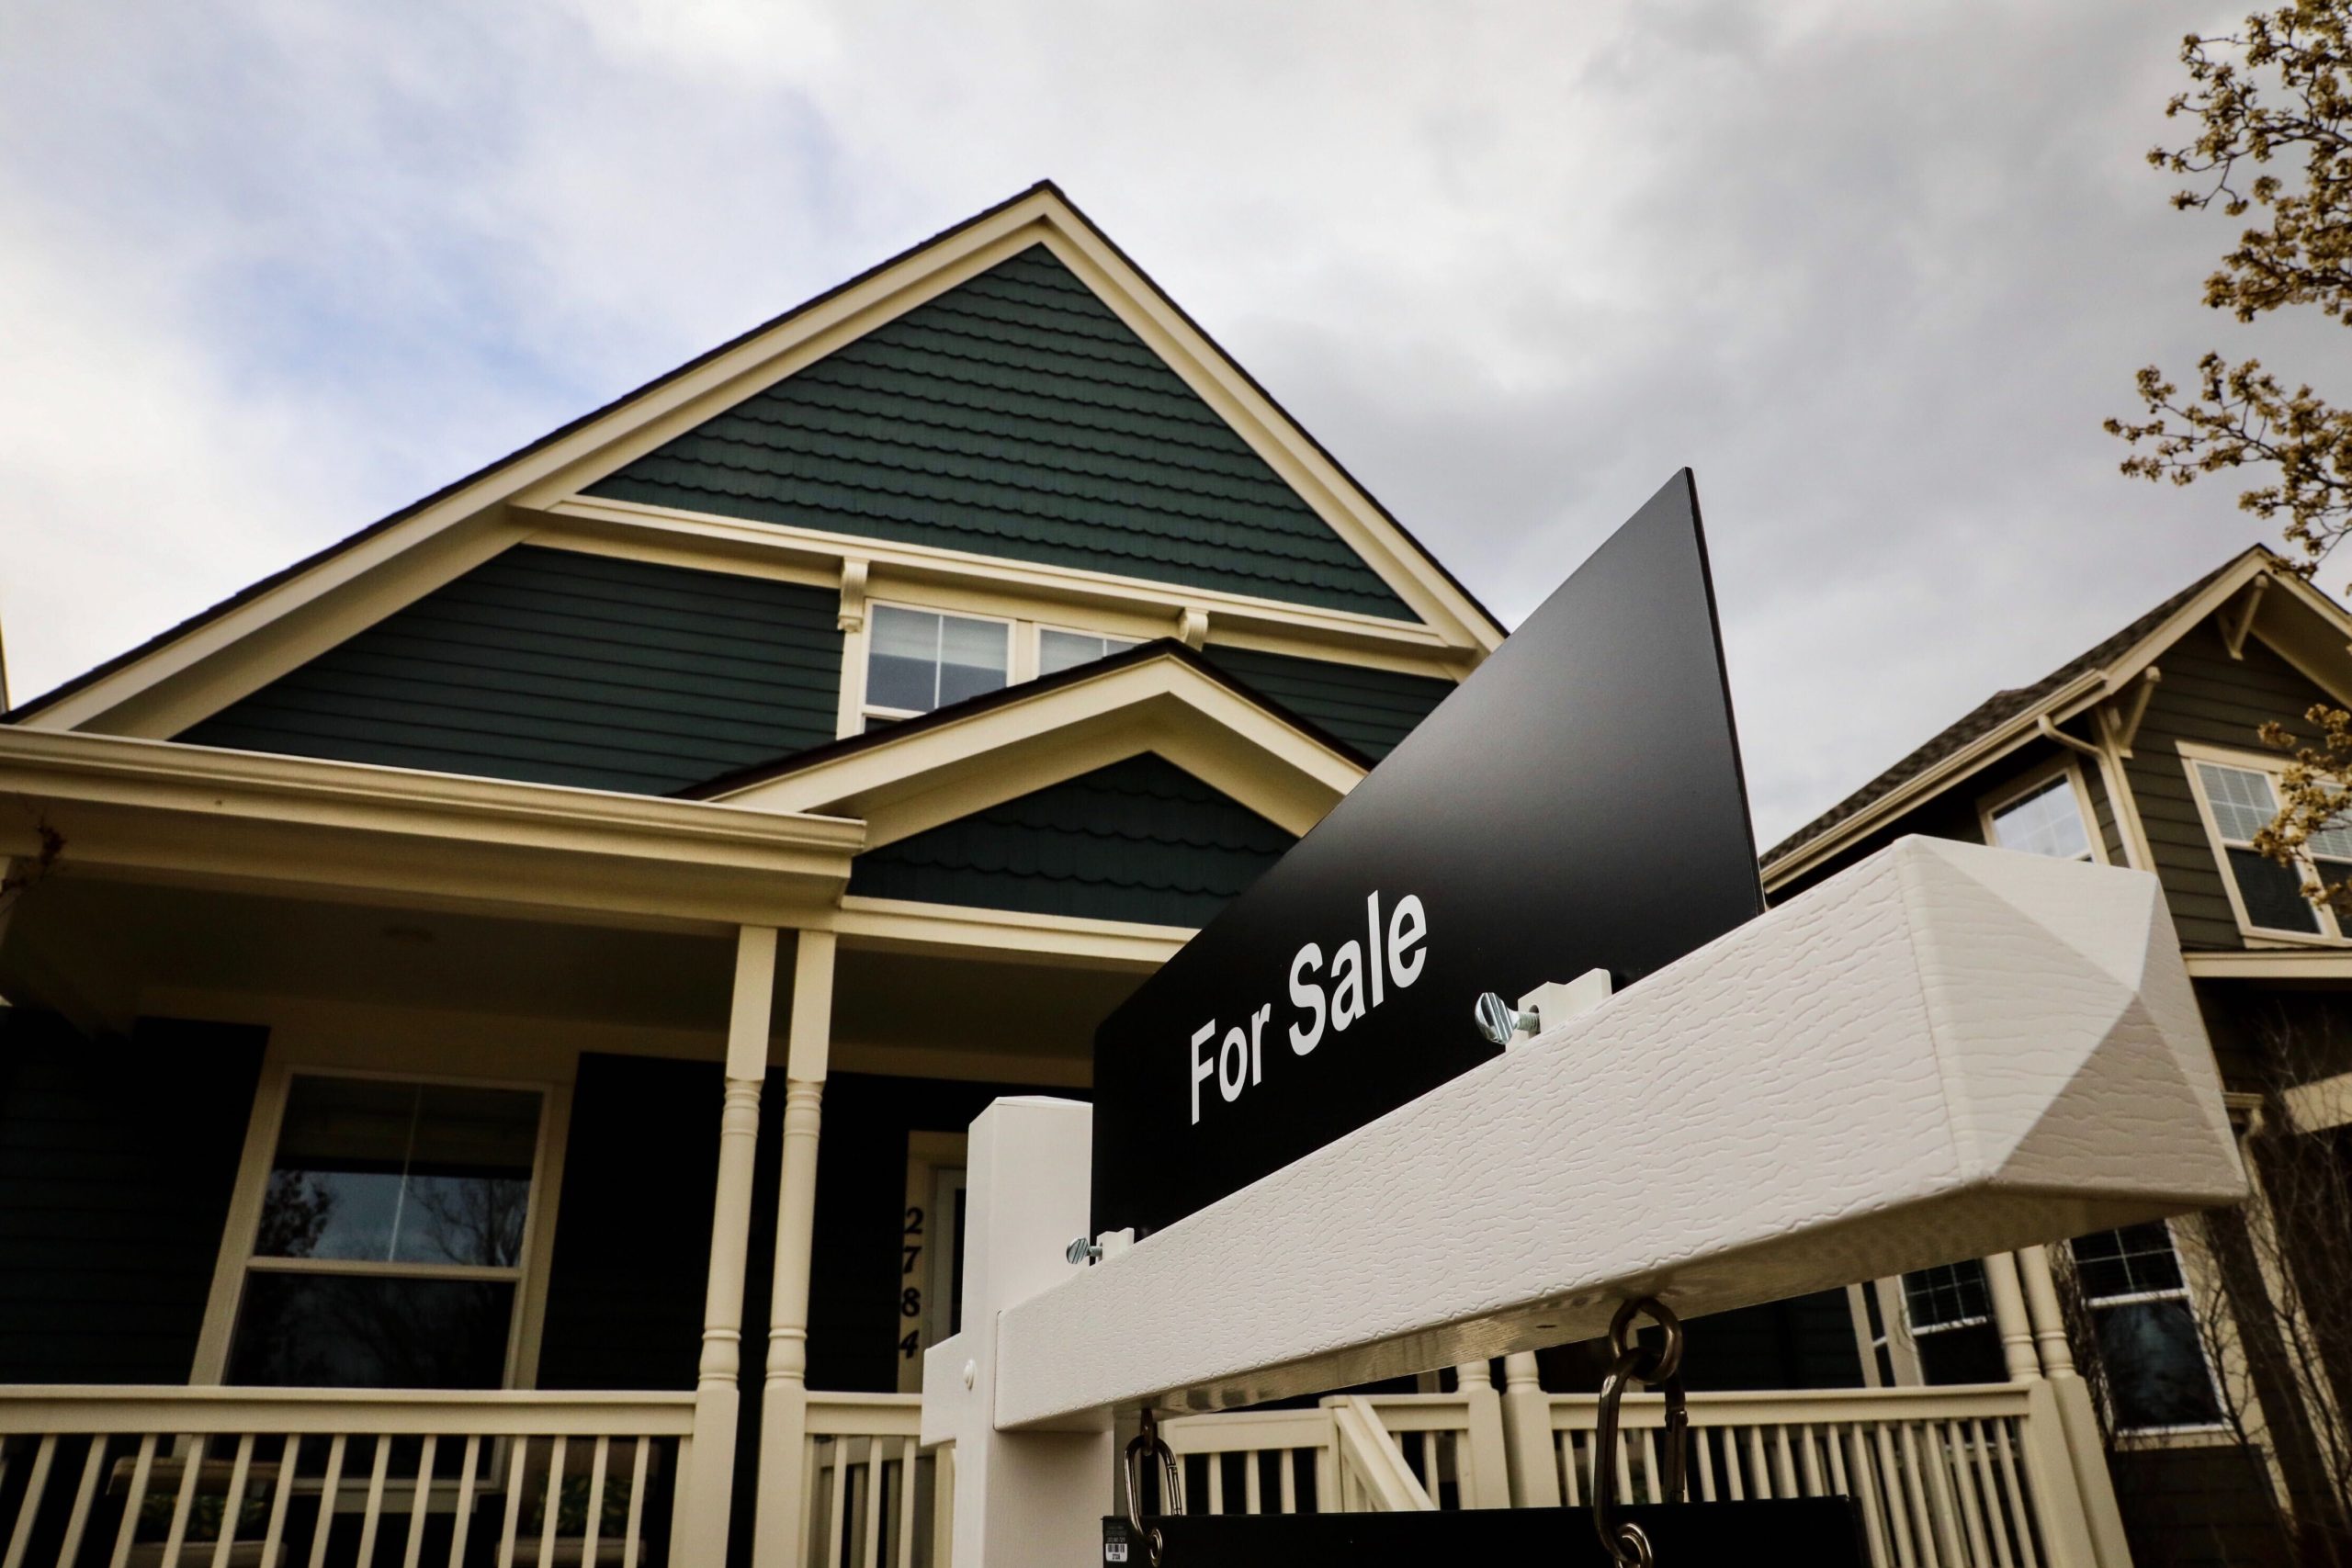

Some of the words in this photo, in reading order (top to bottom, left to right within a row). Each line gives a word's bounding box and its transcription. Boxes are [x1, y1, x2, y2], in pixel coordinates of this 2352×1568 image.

[1192, 1003, 1271, 1125] For
[1289, 890, 1427, 1055] Sale
[899, 1207, 923, 1359] 2784
